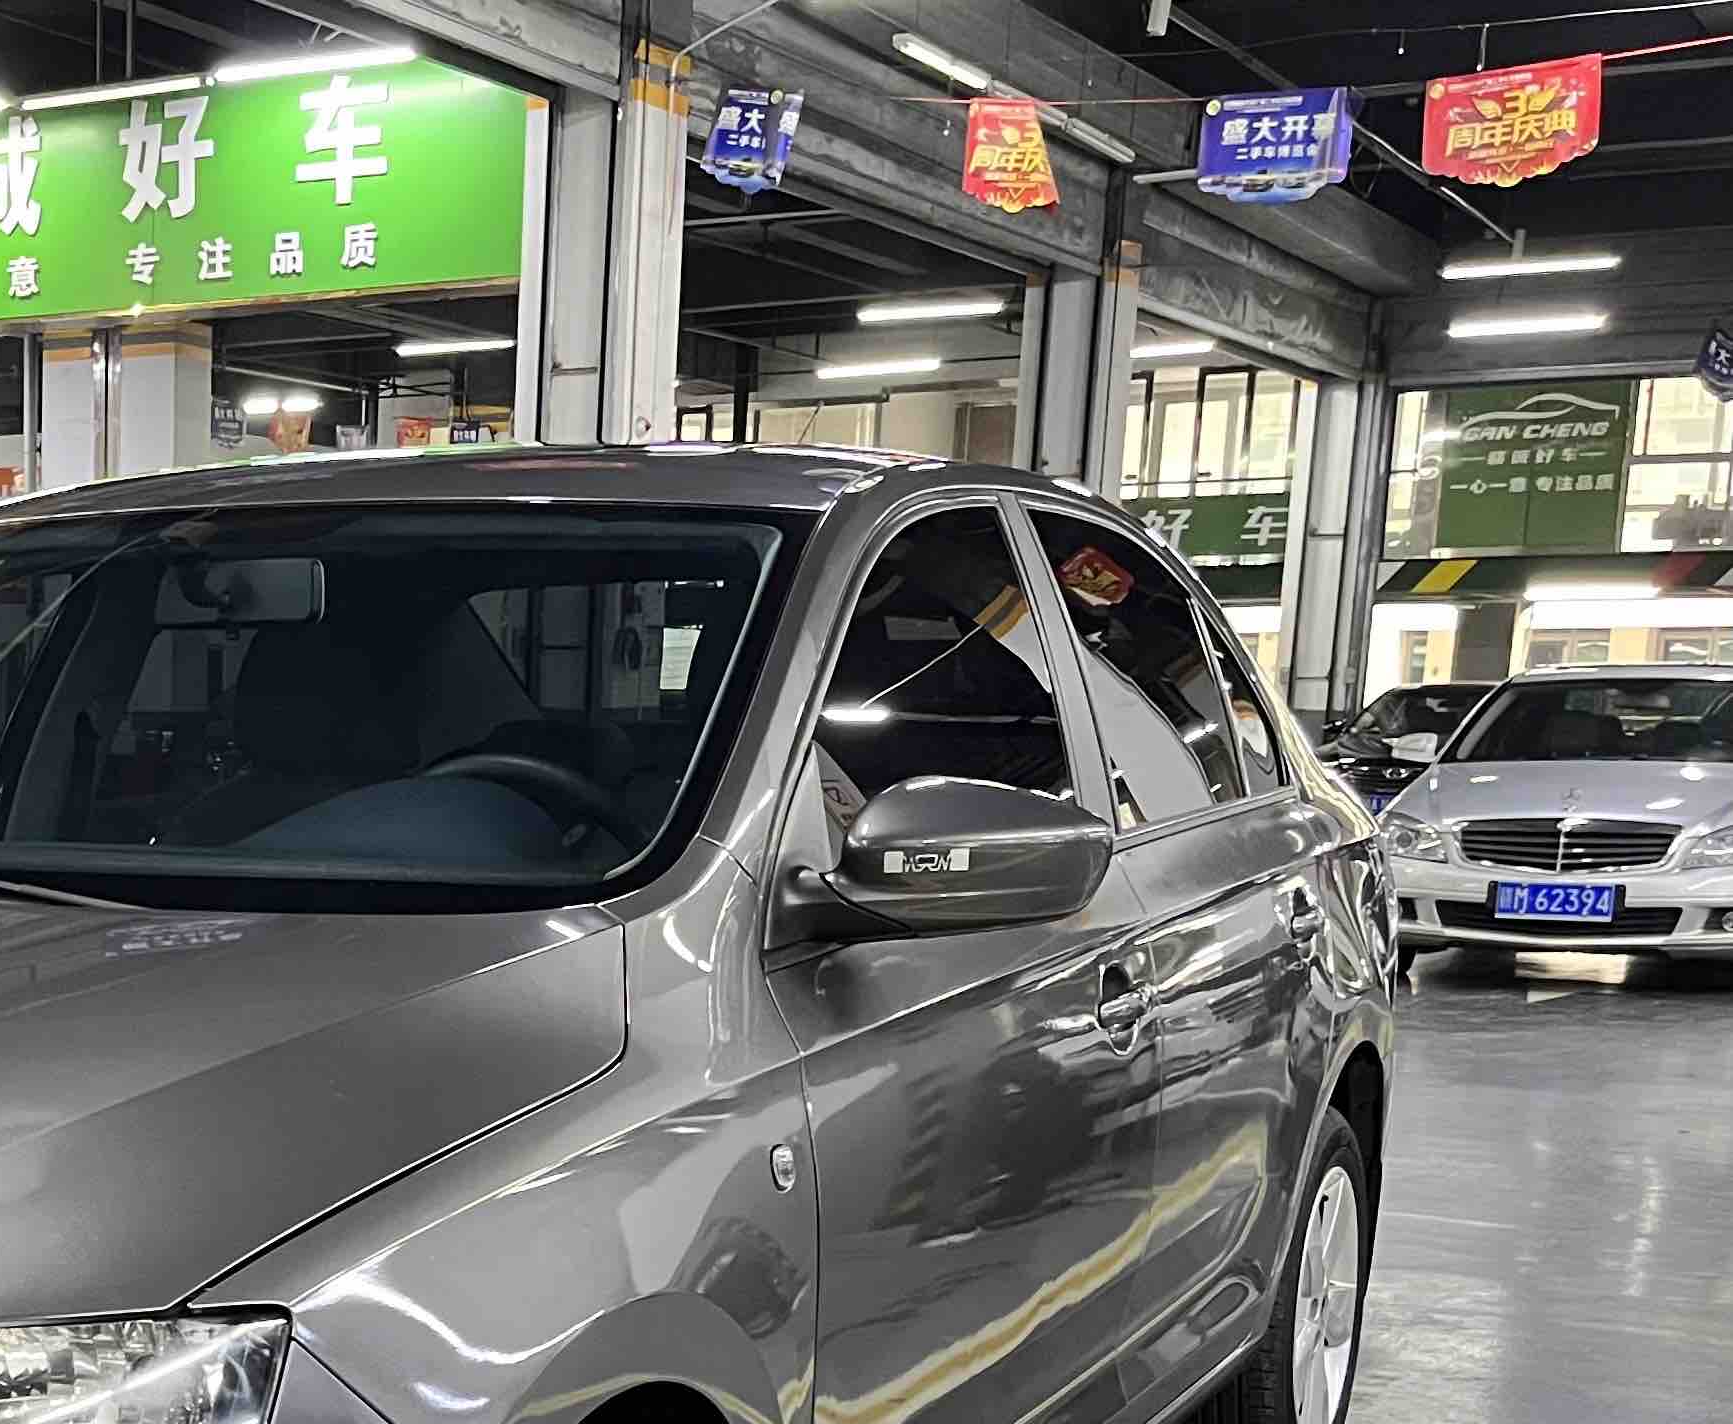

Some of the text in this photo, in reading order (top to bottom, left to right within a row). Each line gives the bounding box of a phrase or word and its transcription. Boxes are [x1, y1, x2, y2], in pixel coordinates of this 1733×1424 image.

[1445, 109, 1577, 159] 周年庆典
[125, 221, 378, 286] 专注品质
[1463, 421, 1610, 442] GAN CHENG
